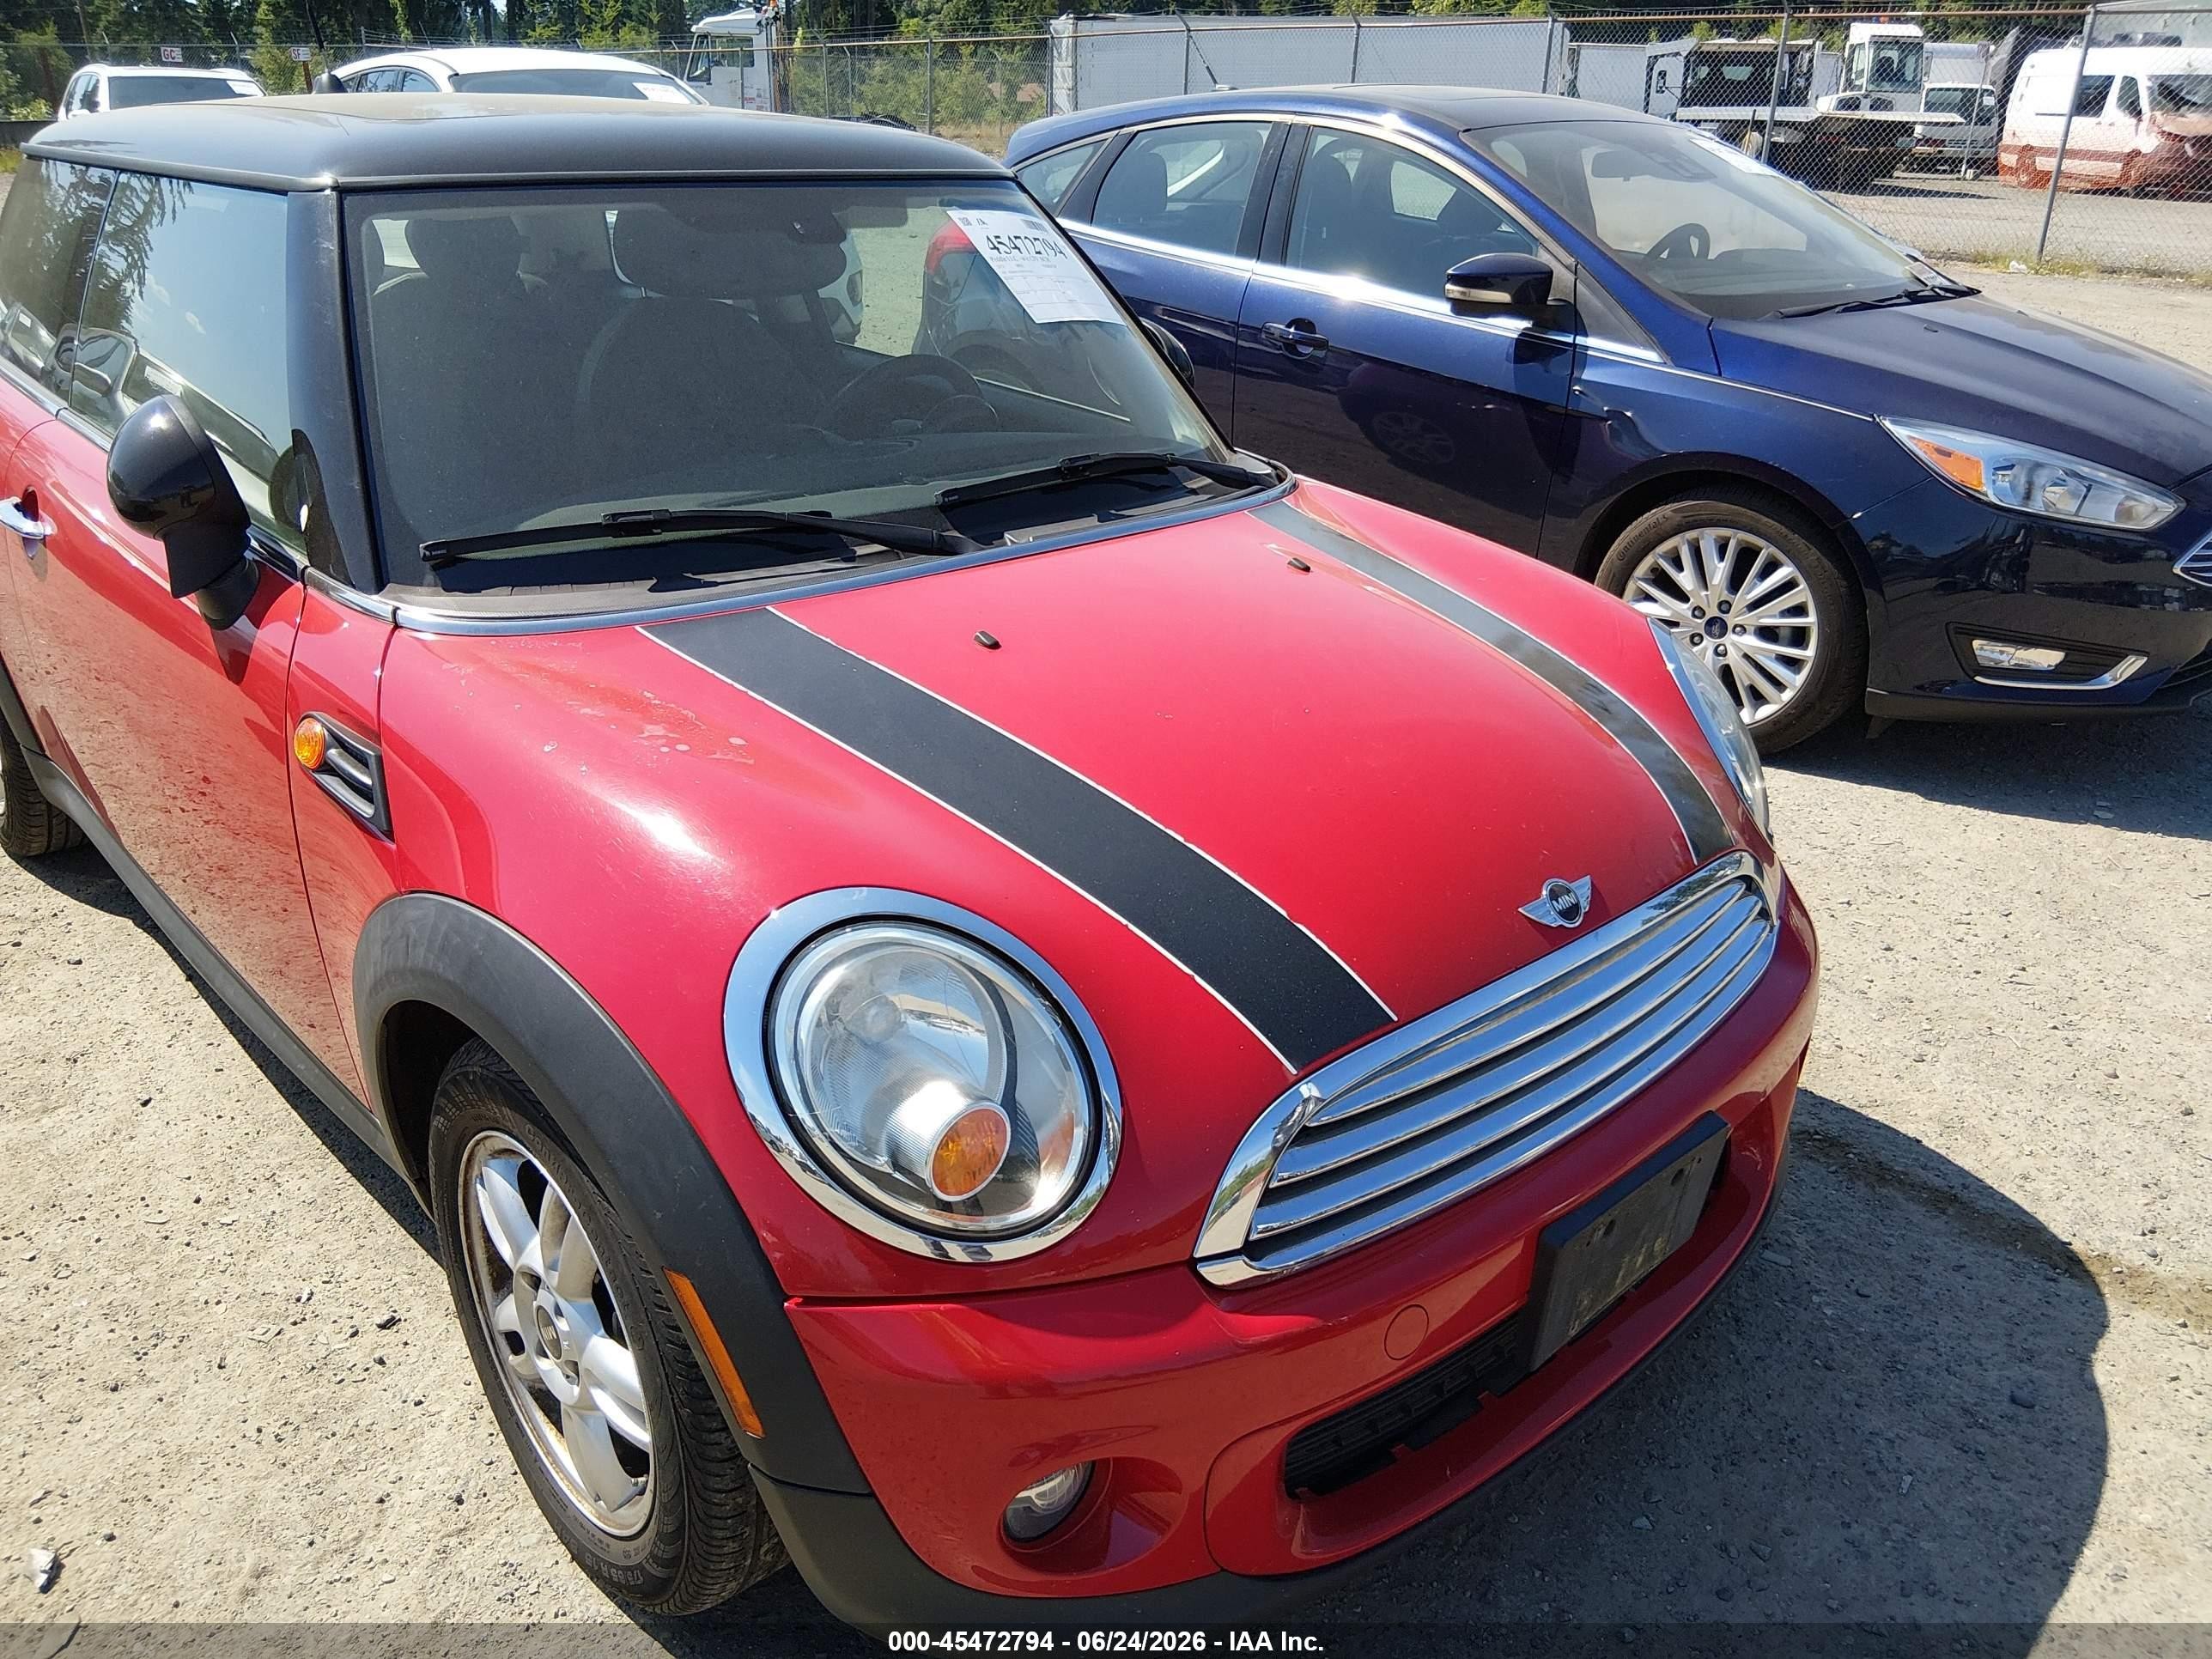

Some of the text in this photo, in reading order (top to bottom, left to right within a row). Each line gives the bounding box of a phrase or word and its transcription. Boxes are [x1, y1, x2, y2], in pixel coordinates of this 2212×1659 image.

[162, 48, 176, 60] GC
[292, 48, 301, 60] SF
[986, 234, 1067, 259] 45472794
[1551, 892, 1577, 912] MINI
